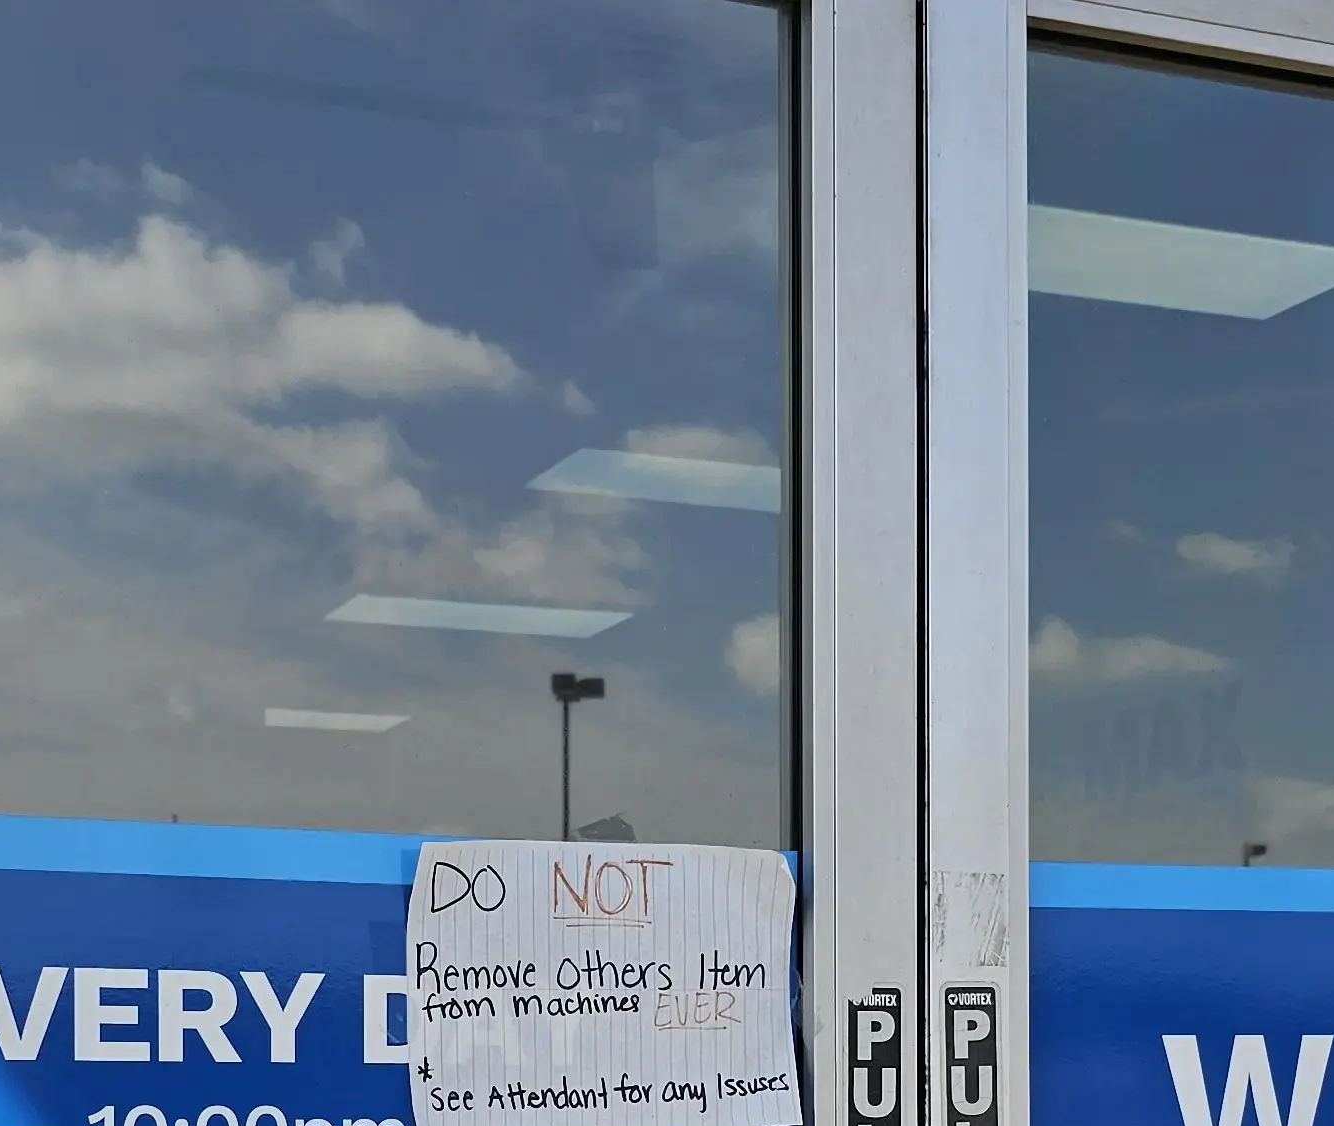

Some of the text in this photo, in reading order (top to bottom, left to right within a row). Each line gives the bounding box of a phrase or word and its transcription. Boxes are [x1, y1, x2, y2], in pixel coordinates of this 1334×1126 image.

[430, 854, 674, 917] DO NOT
[415, 940, 537, 995] Remove
[699, 949, 766, 991] Item
[421, 992, 496, 1023] from
[653, 991, 742, 1028] EVER
[863, 993, 897, 1006] VORTEX
[959, 993, 992, 1005] VORTEX
[487, 1075, 608, 1111] Attendant
[613, 1072, 653, 1104] for
[661, 1080, 707, 1114] any
